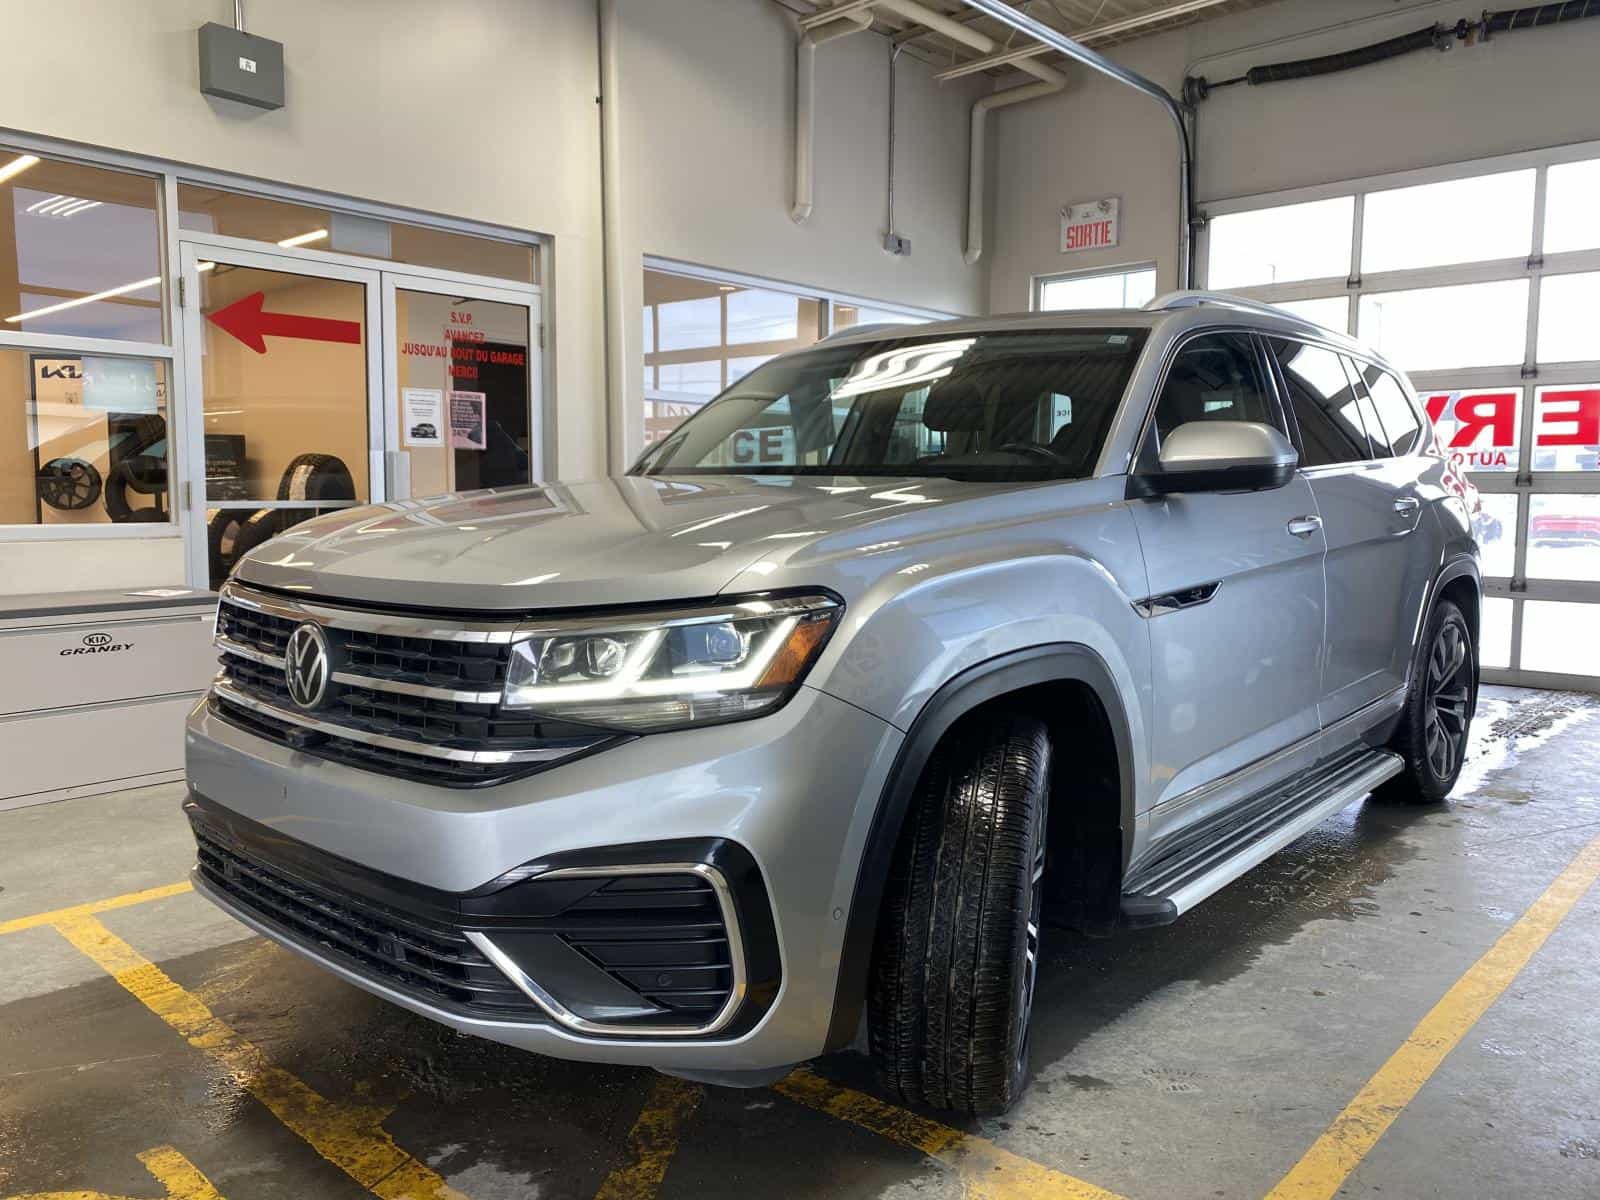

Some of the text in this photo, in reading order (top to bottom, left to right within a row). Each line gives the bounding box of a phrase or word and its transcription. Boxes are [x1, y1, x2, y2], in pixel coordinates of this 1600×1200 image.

[1066, 220, 1112, 249] SORTIE
[451, 312, 472, 325] S.V.P.
[402, 343, 524, 366] JUSQU'AU BOUT DU GARAGE
[88, 636, 107, 644] KIA
[59, 643, 134, 655] GRANBY
